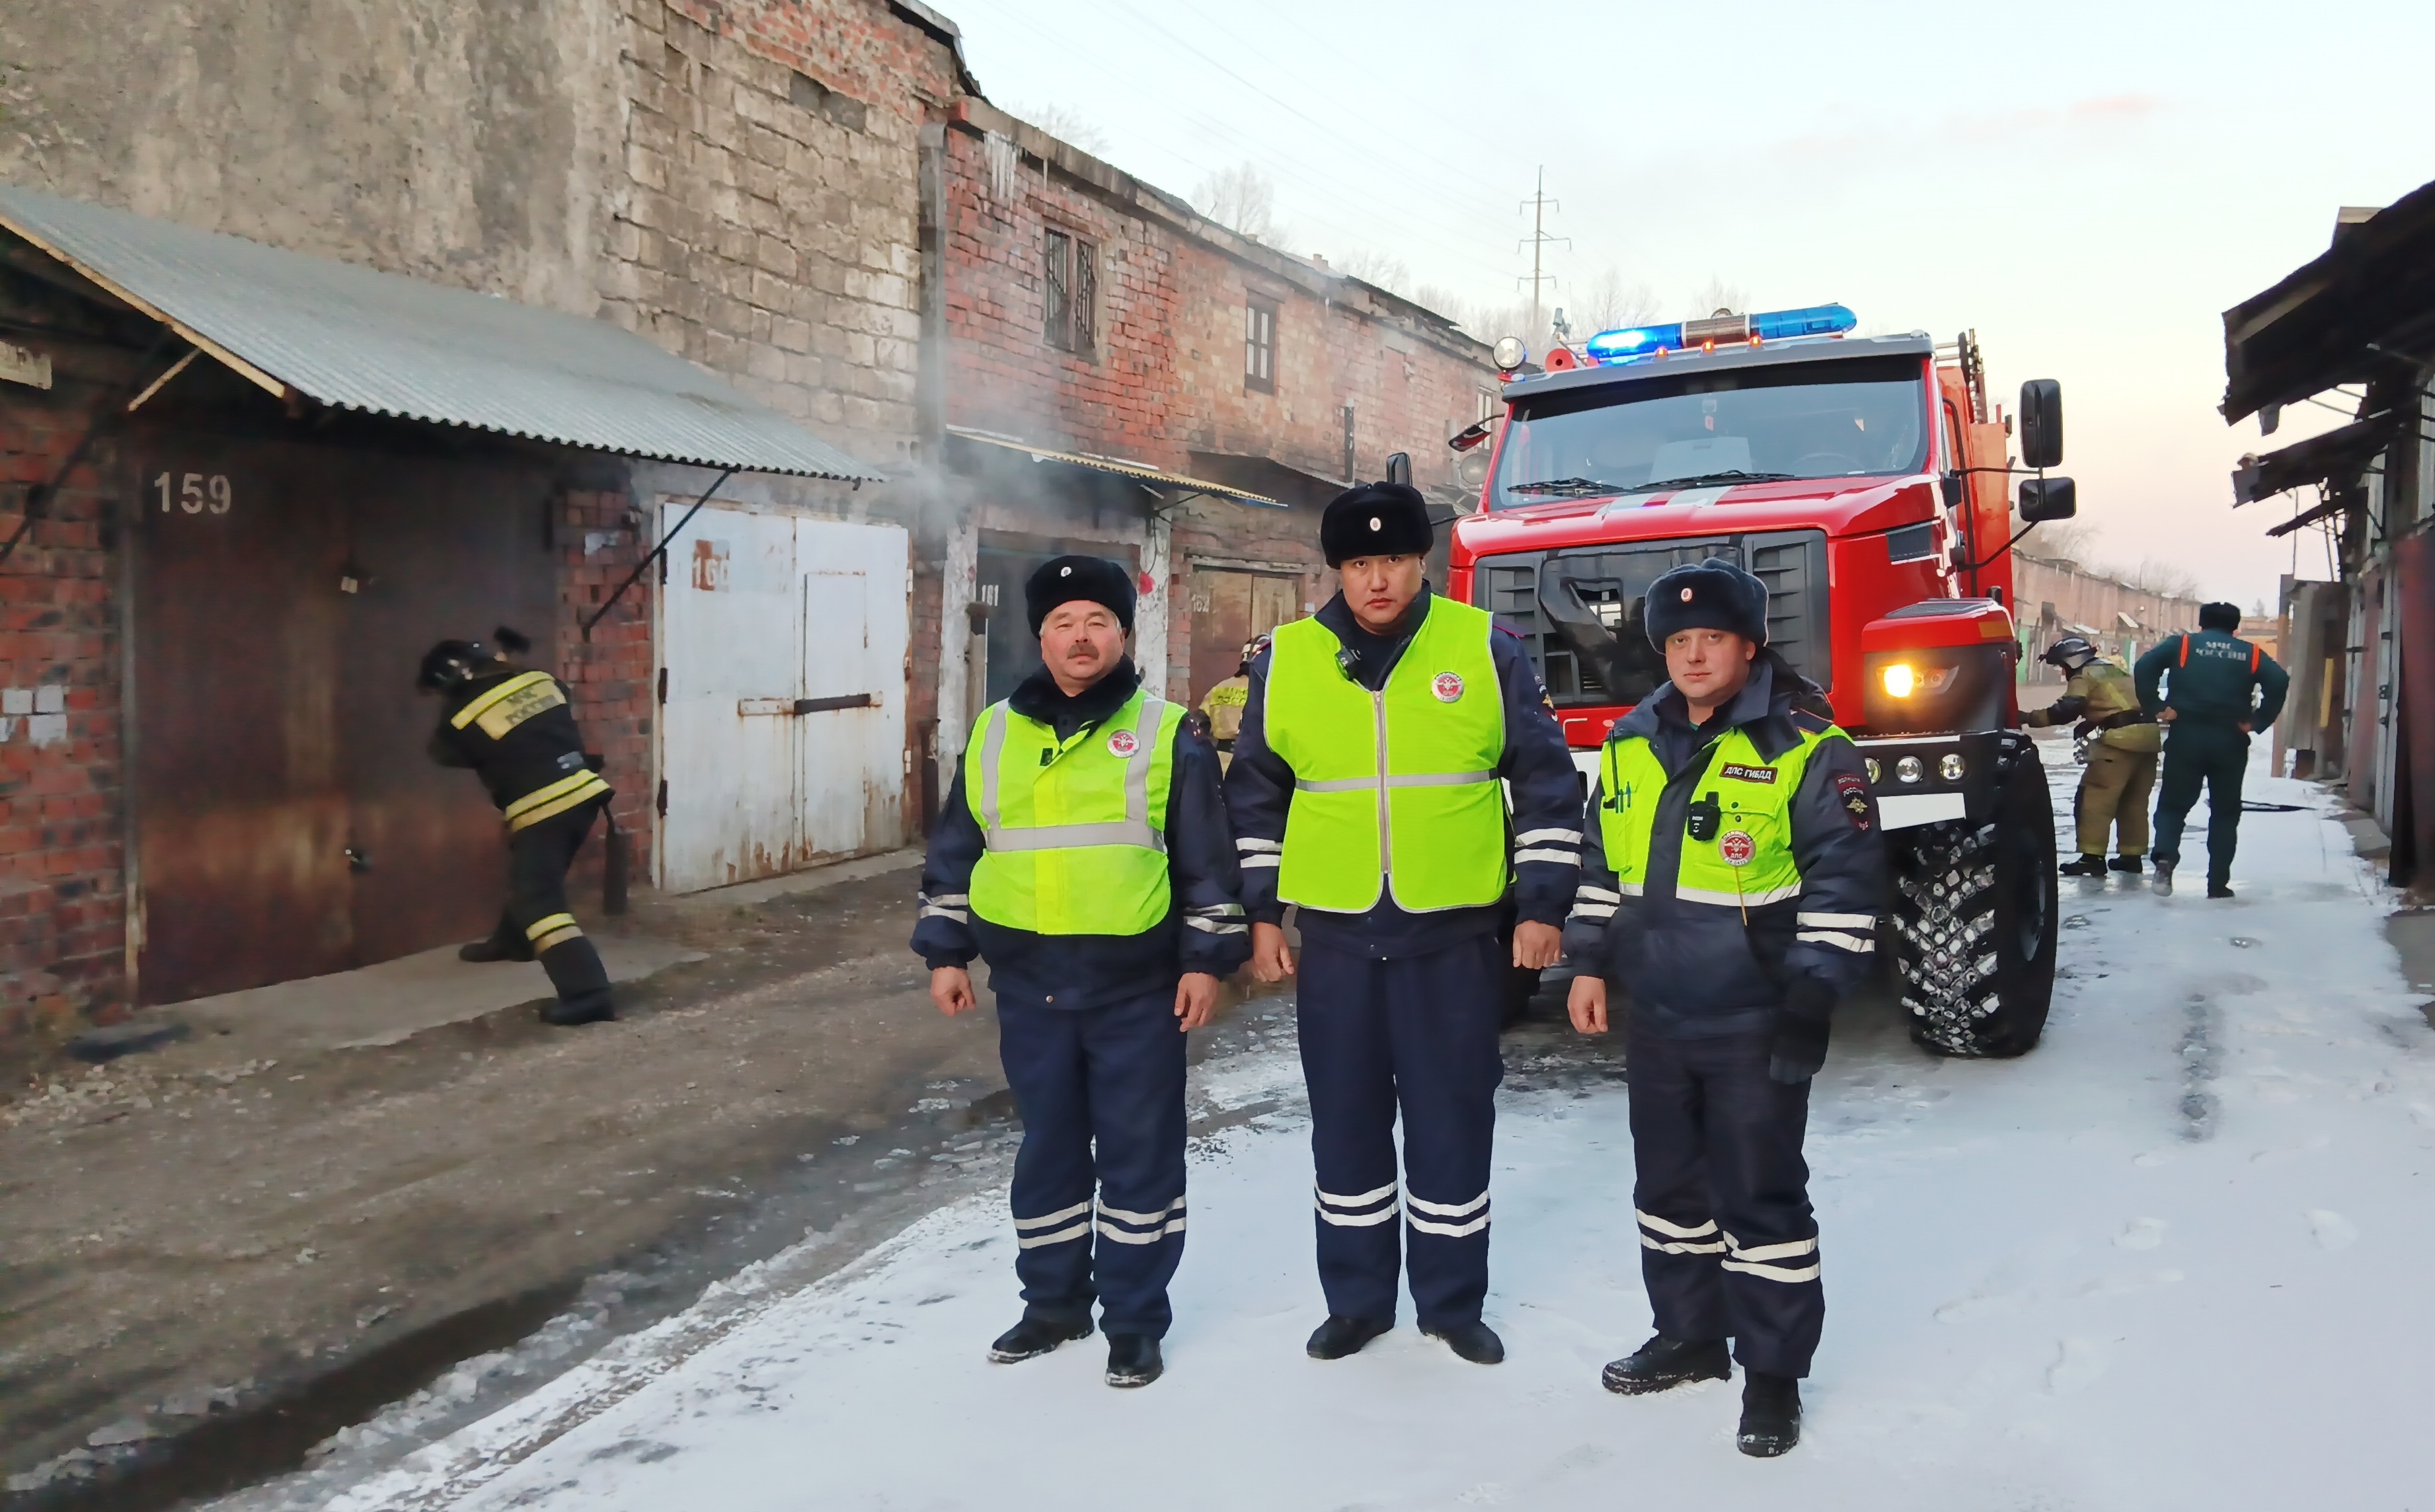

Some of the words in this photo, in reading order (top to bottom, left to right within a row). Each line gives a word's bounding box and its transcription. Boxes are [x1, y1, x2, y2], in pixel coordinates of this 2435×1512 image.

[154, 471, 231, 514] 159
[982, 584, 999, 606] 161
[1191, 594, 1210, 613] 162
[1724, 767, 1744, 775] ДПС
[1744, 769, 1772, 780] ГИБДД
